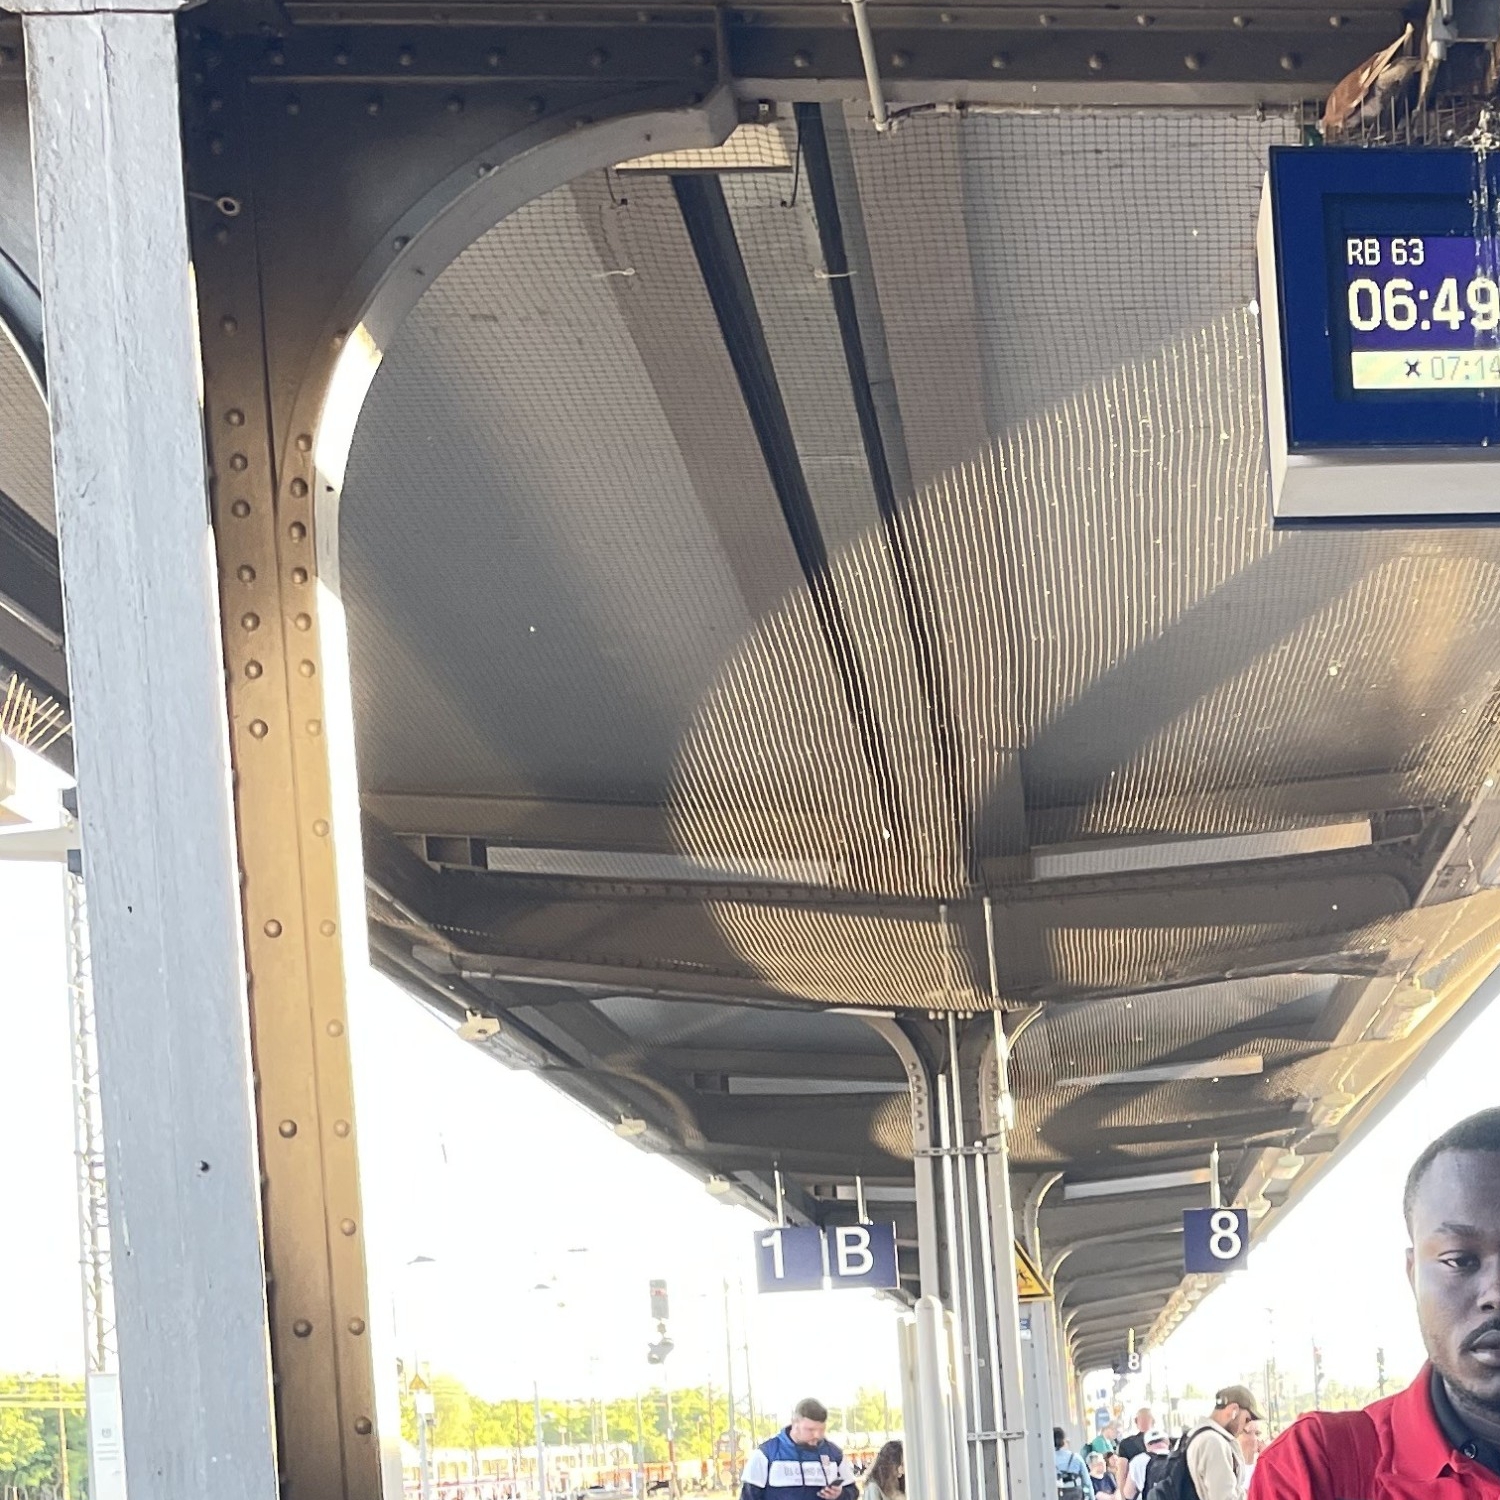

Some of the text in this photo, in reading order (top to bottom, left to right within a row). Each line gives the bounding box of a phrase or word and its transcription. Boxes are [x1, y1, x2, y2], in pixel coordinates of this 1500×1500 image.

[1347, 238, 1425, 266] RB 63
[1347, 277, 1500, 332] 06:49
[761, 1229, 785, 1279] 1
[835, 1226, 874, 1276] B
[1209, 1210, 1242, 1260] 8
[1127, 1352, 1140, 1371] 8
